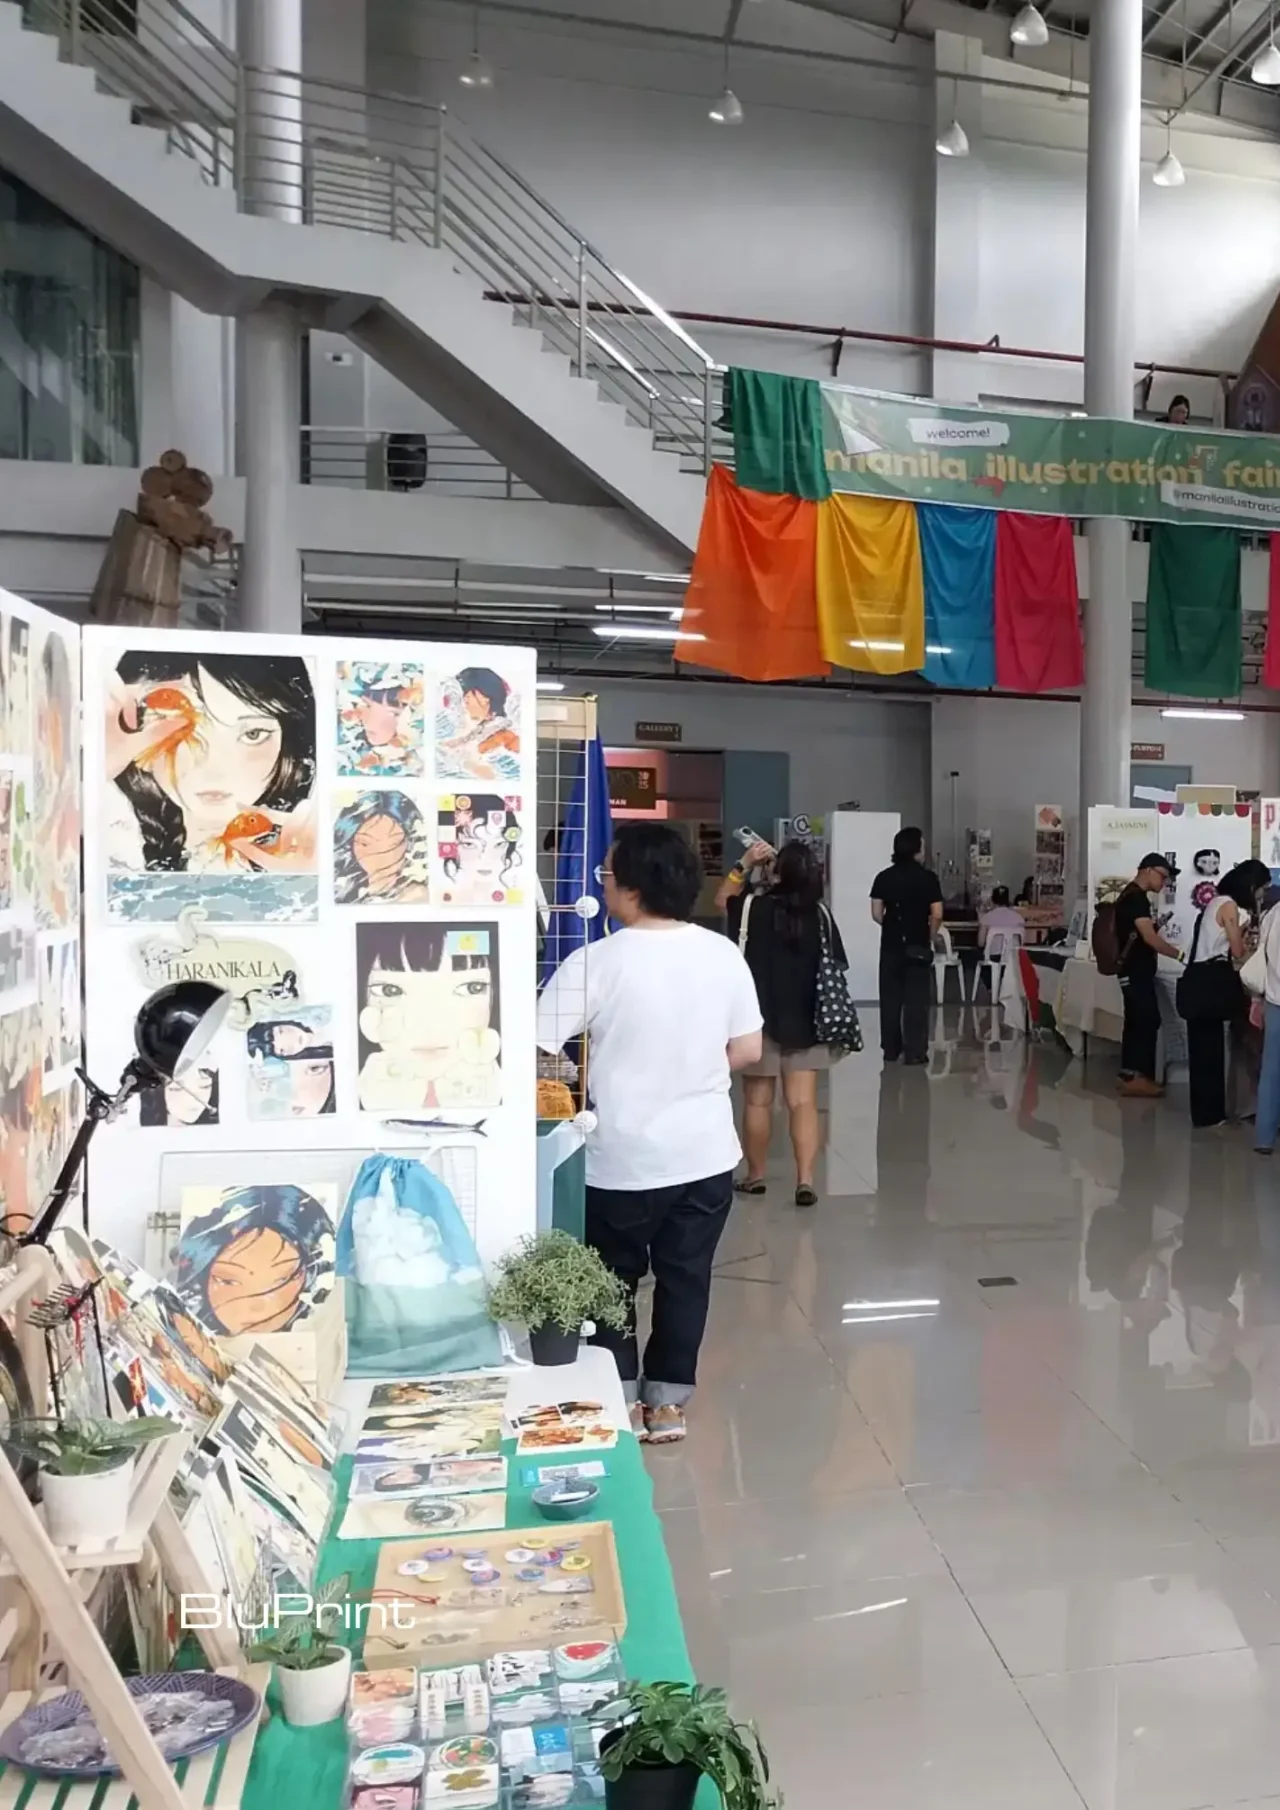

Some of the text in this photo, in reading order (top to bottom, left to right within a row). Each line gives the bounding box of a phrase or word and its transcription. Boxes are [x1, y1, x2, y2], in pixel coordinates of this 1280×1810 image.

[926, 426, 991, 439] welcome!
[824, 448, 968, 482] manila
[984, 451, 1205, 486] illustration
[166, 960, 281, 980] HARANIKALA
